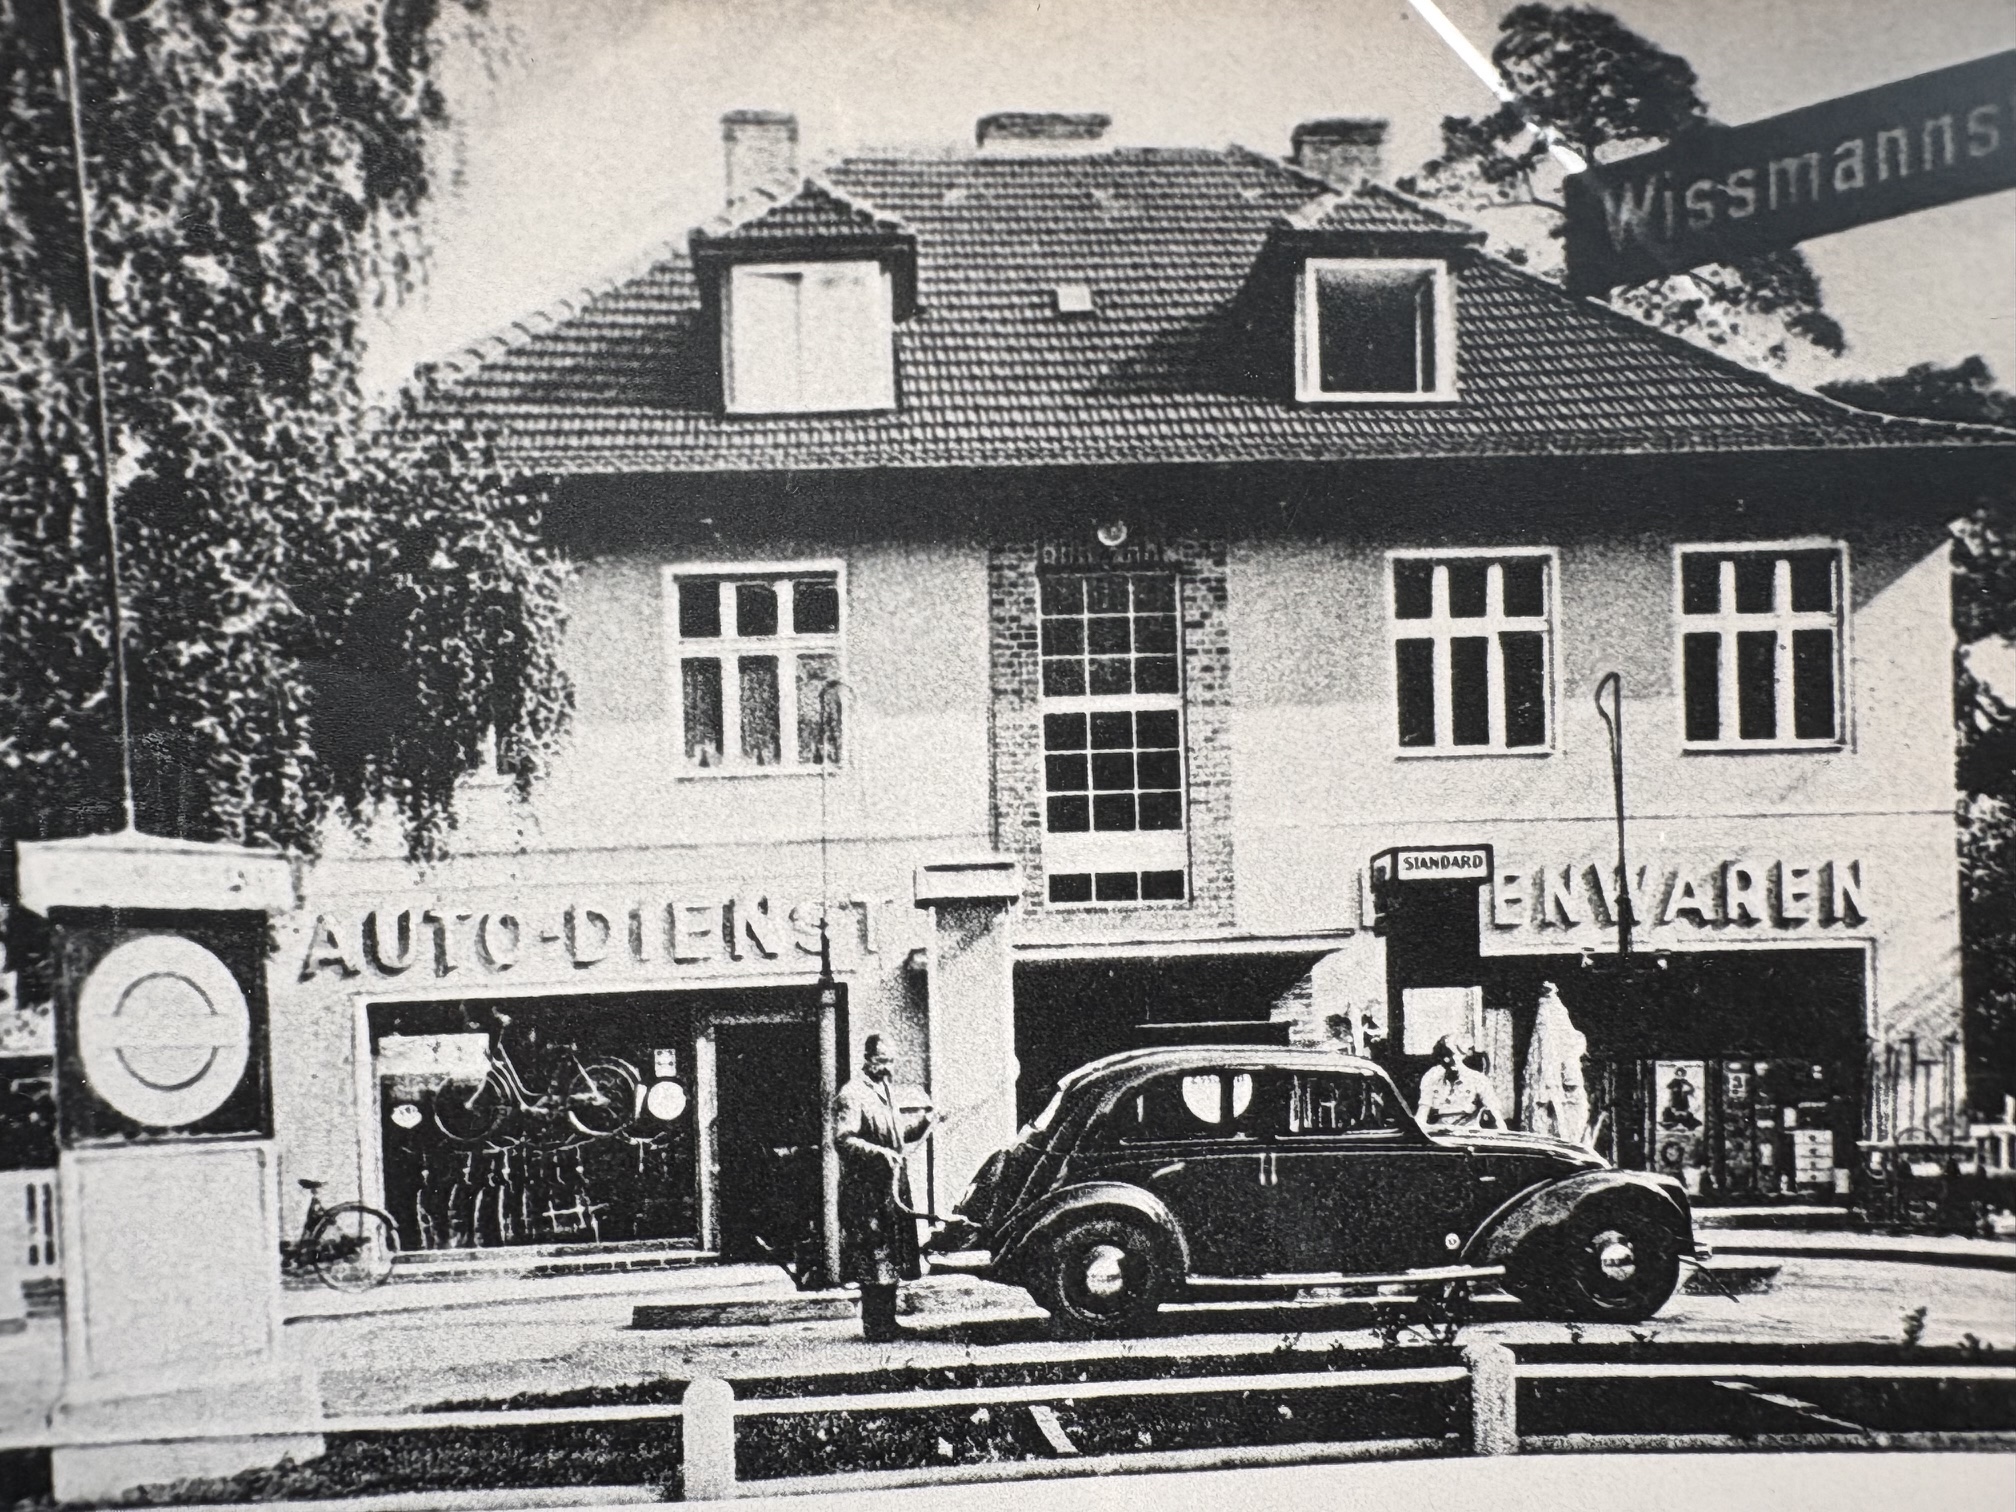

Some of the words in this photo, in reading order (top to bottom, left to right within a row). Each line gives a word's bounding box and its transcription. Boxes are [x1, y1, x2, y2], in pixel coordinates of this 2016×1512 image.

[1602, 103, 2015, 252] Wissmanns
[1402, 854, 1483, 871] STANDARD
[297, 895, 894, 983] AUTO-DIENST
